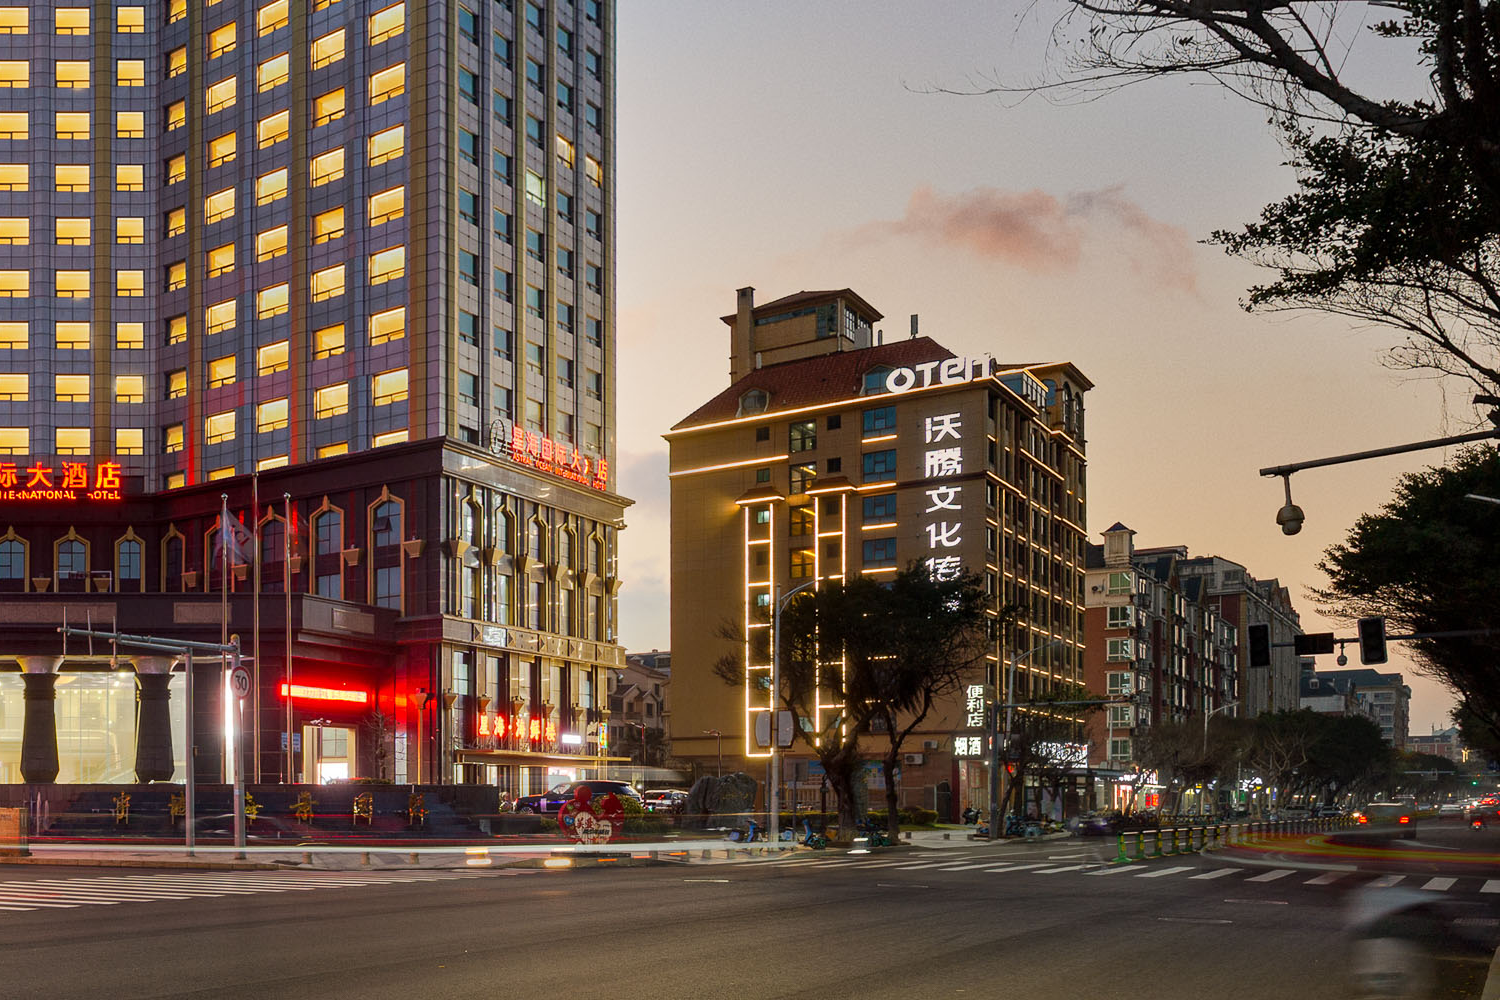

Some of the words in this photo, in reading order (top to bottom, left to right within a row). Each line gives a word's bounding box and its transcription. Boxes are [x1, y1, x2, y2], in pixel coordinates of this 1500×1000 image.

[235, 675, 248, 691] 30
[966, 684, 984, 727] 便利店
[954, 737, 981, 756] 烟酒
